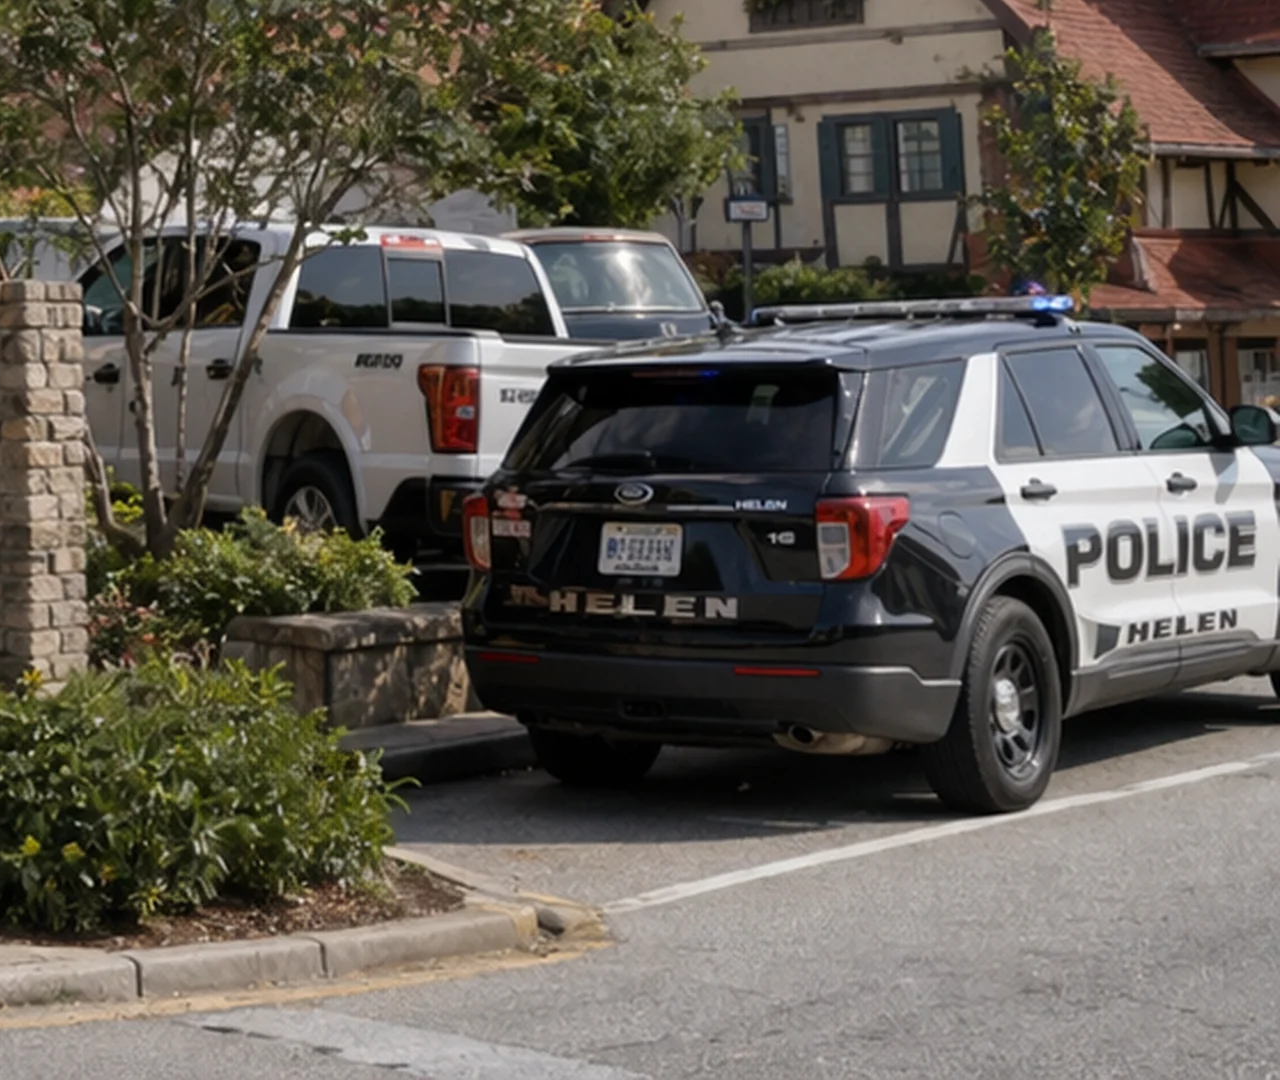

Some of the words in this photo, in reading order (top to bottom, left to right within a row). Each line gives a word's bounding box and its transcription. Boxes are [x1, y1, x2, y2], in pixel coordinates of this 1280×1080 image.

[1061, 510, 1257, 589] POLICE
[549, 589, 738, 619] HELEN
[1127, 609, 1238, 645] HELEN
